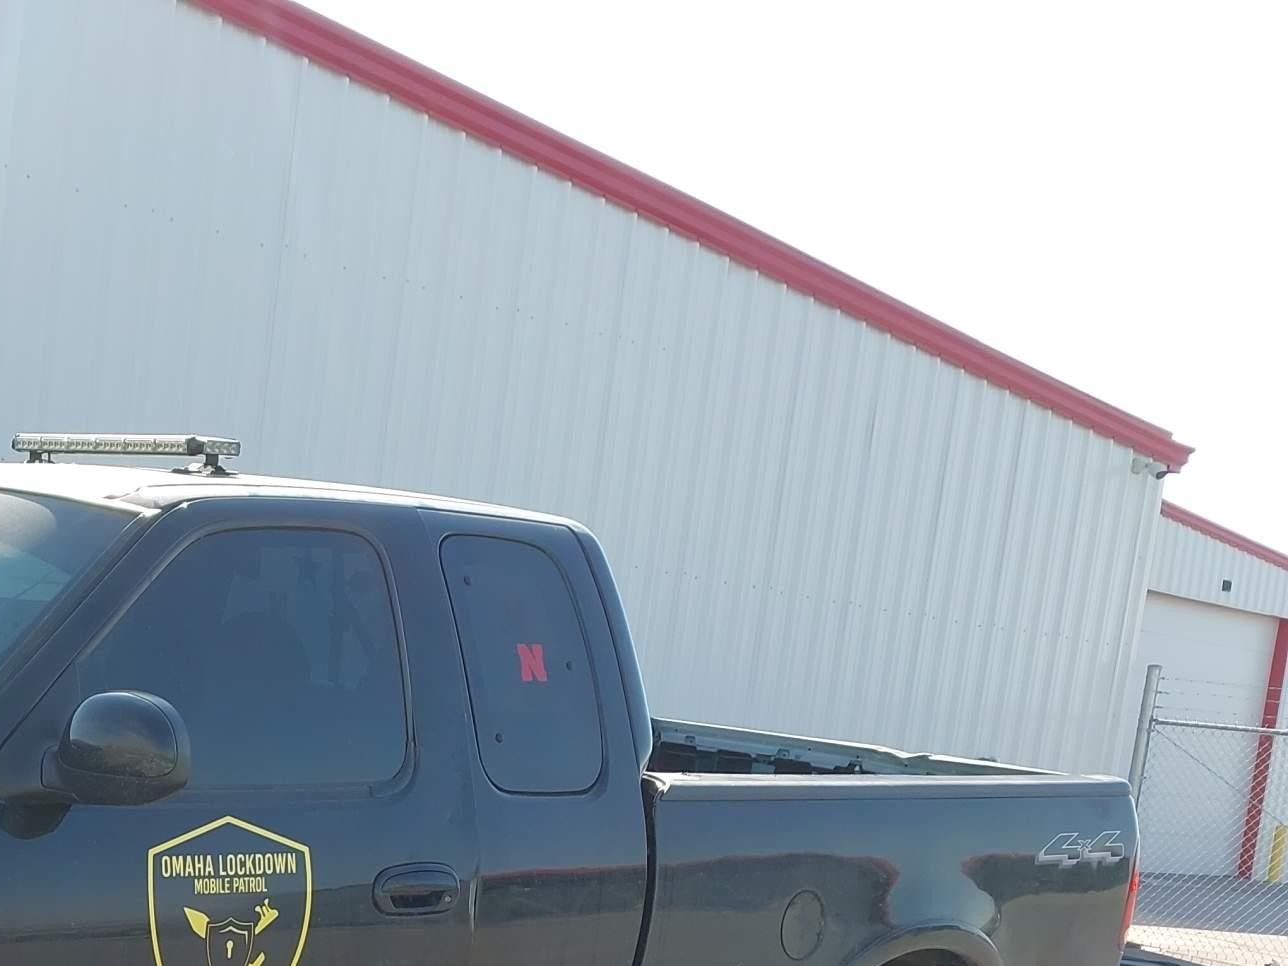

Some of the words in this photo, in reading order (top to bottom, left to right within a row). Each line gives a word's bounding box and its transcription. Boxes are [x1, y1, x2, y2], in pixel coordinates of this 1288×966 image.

[516, 643, 548, 682] N
[161, 854, 215, 878] OMAHA
[218, 852, 297, 876] LOCKDOWN
[194, 878, 231, 895] MOBILE
[233, 876, 268, 893] PATROL
